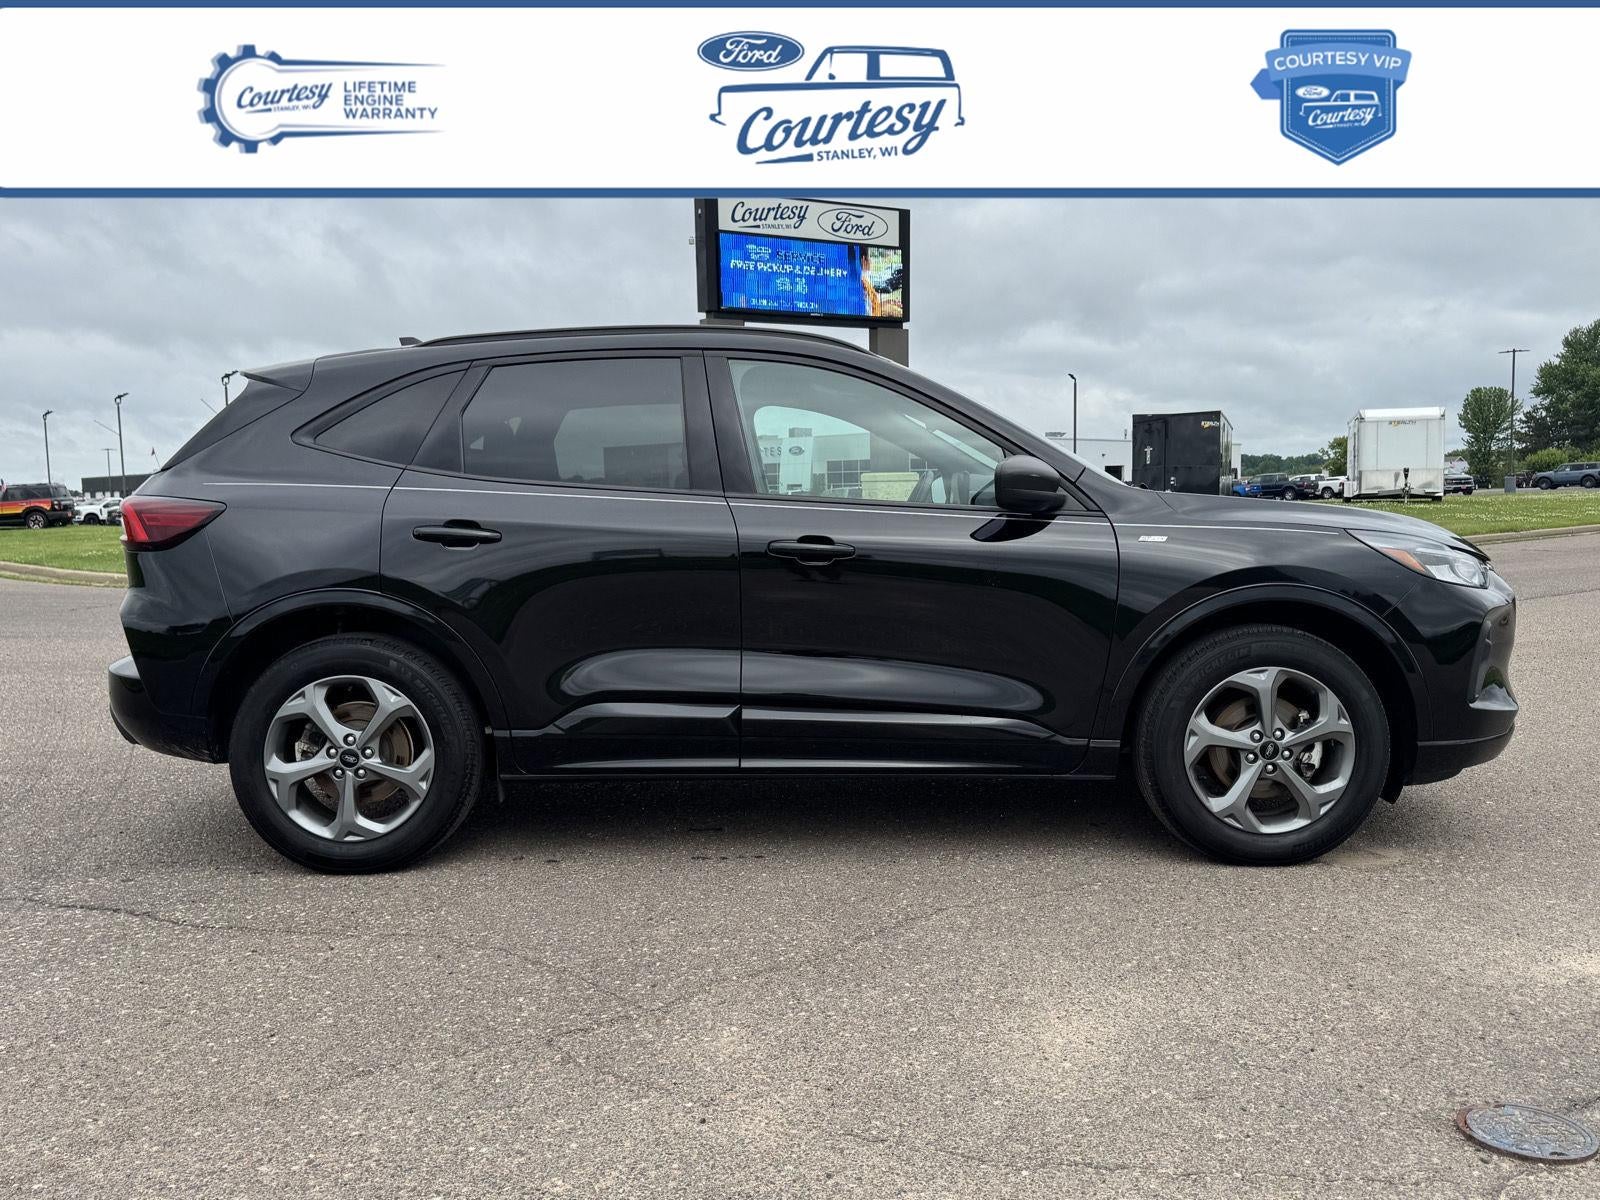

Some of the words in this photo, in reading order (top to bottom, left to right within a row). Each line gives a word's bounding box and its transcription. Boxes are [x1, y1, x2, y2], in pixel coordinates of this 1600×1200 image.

[731, 201, 810, 229] Courtesy
[831, 210, 876, 237] Ford
[730, 259, 755, 271] FREE
[757, 262, 793, 273] PICKUP
